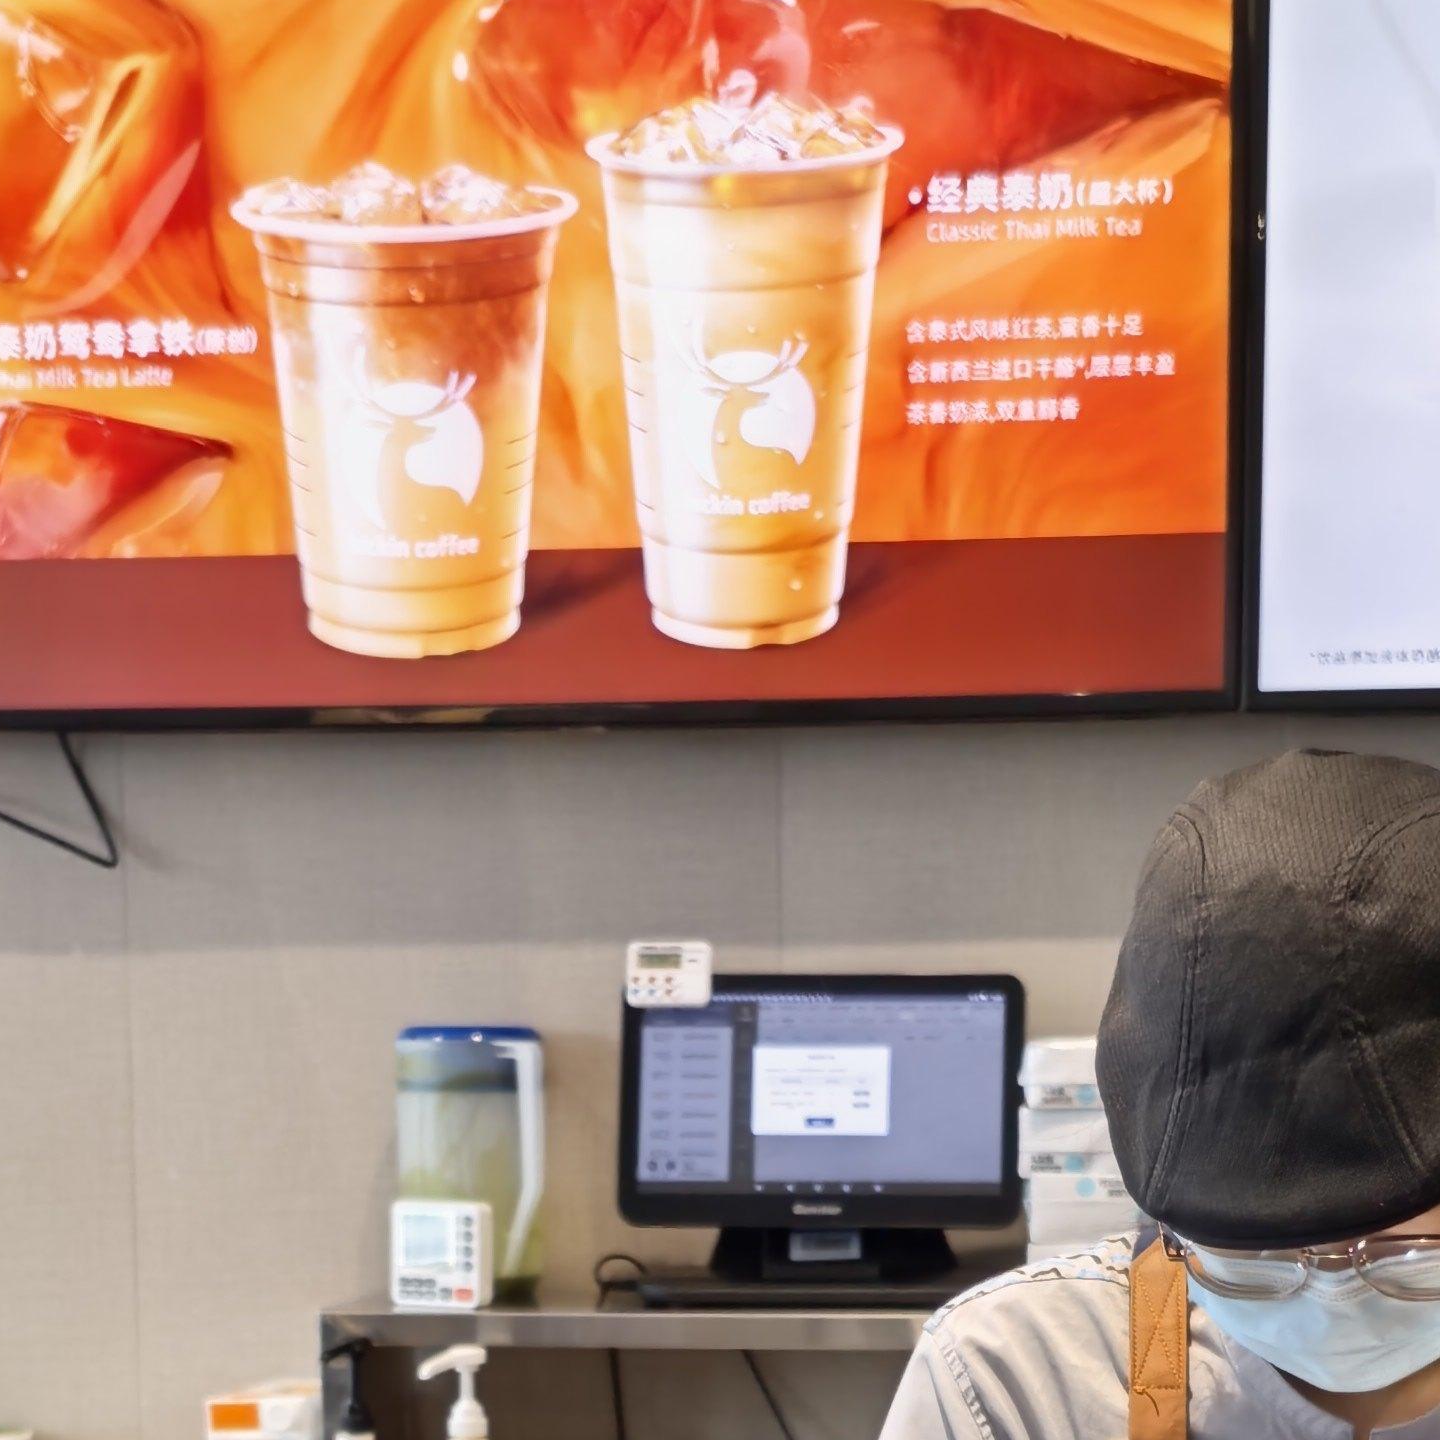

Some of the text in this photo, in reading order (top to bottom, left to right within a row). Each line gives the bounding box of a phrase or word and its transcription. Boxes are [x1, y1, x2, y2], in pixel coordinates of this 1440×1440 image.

[925, 215, 1144, 244] Classic Thai Milk Tea
